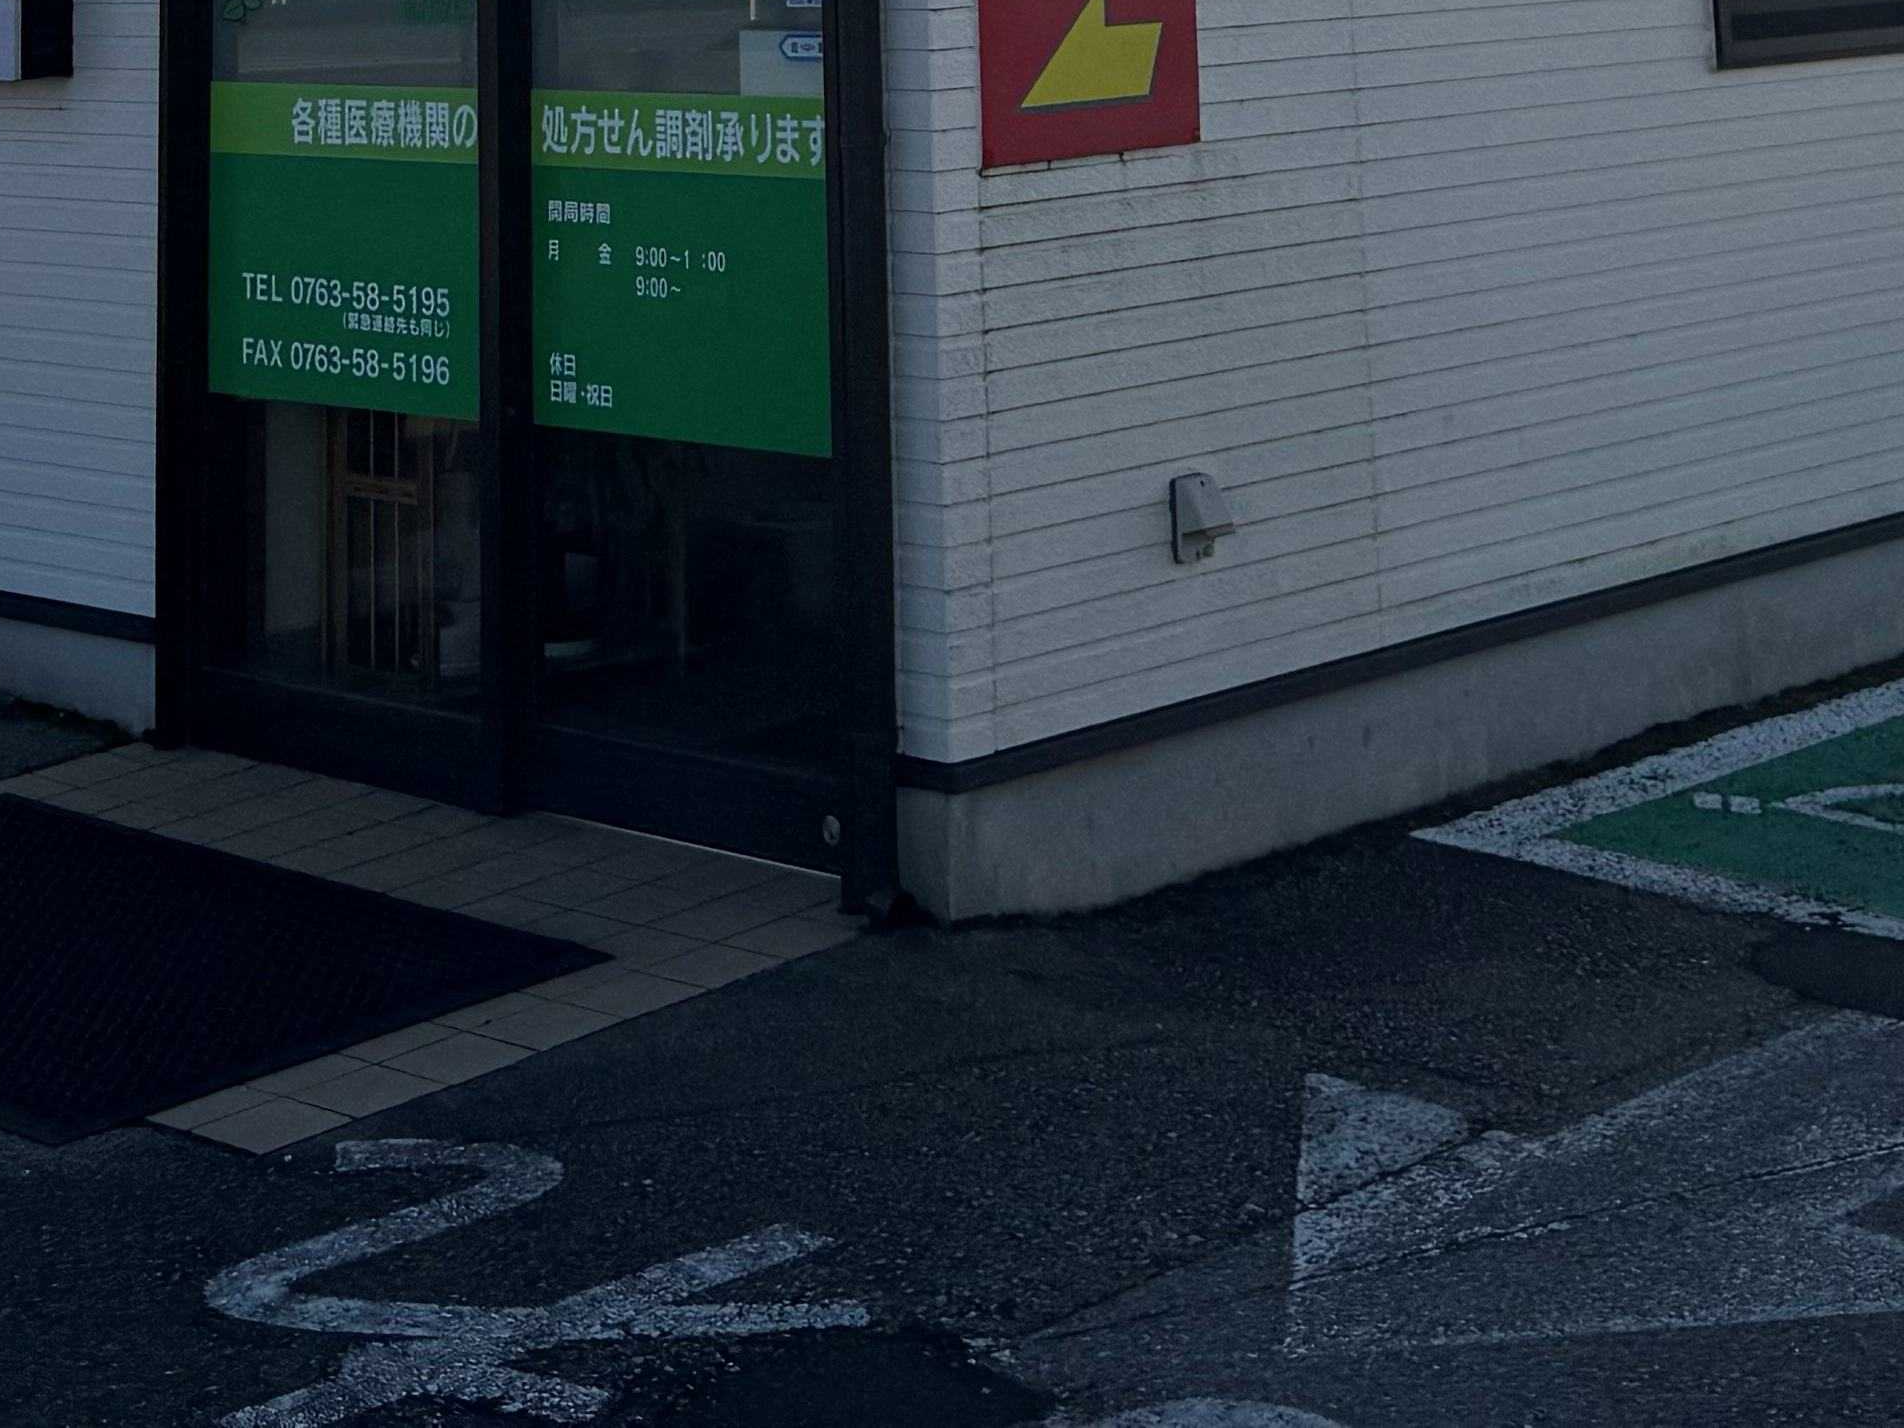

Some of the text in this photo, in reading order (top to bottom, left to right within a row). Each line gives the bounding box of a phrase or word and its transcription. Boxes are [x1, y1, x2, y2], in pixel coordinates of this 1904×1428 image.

[291, 97, 825, 165] 各種医療機関の 処方せん調剤承ります
[598, 243, 612, 265] 金
[242, 272, 450, 317] TEL 0763-58-5195
[242, 338, 450, 385] FAX 0763-58-5196
[550, 352, 576, 376] 休日
